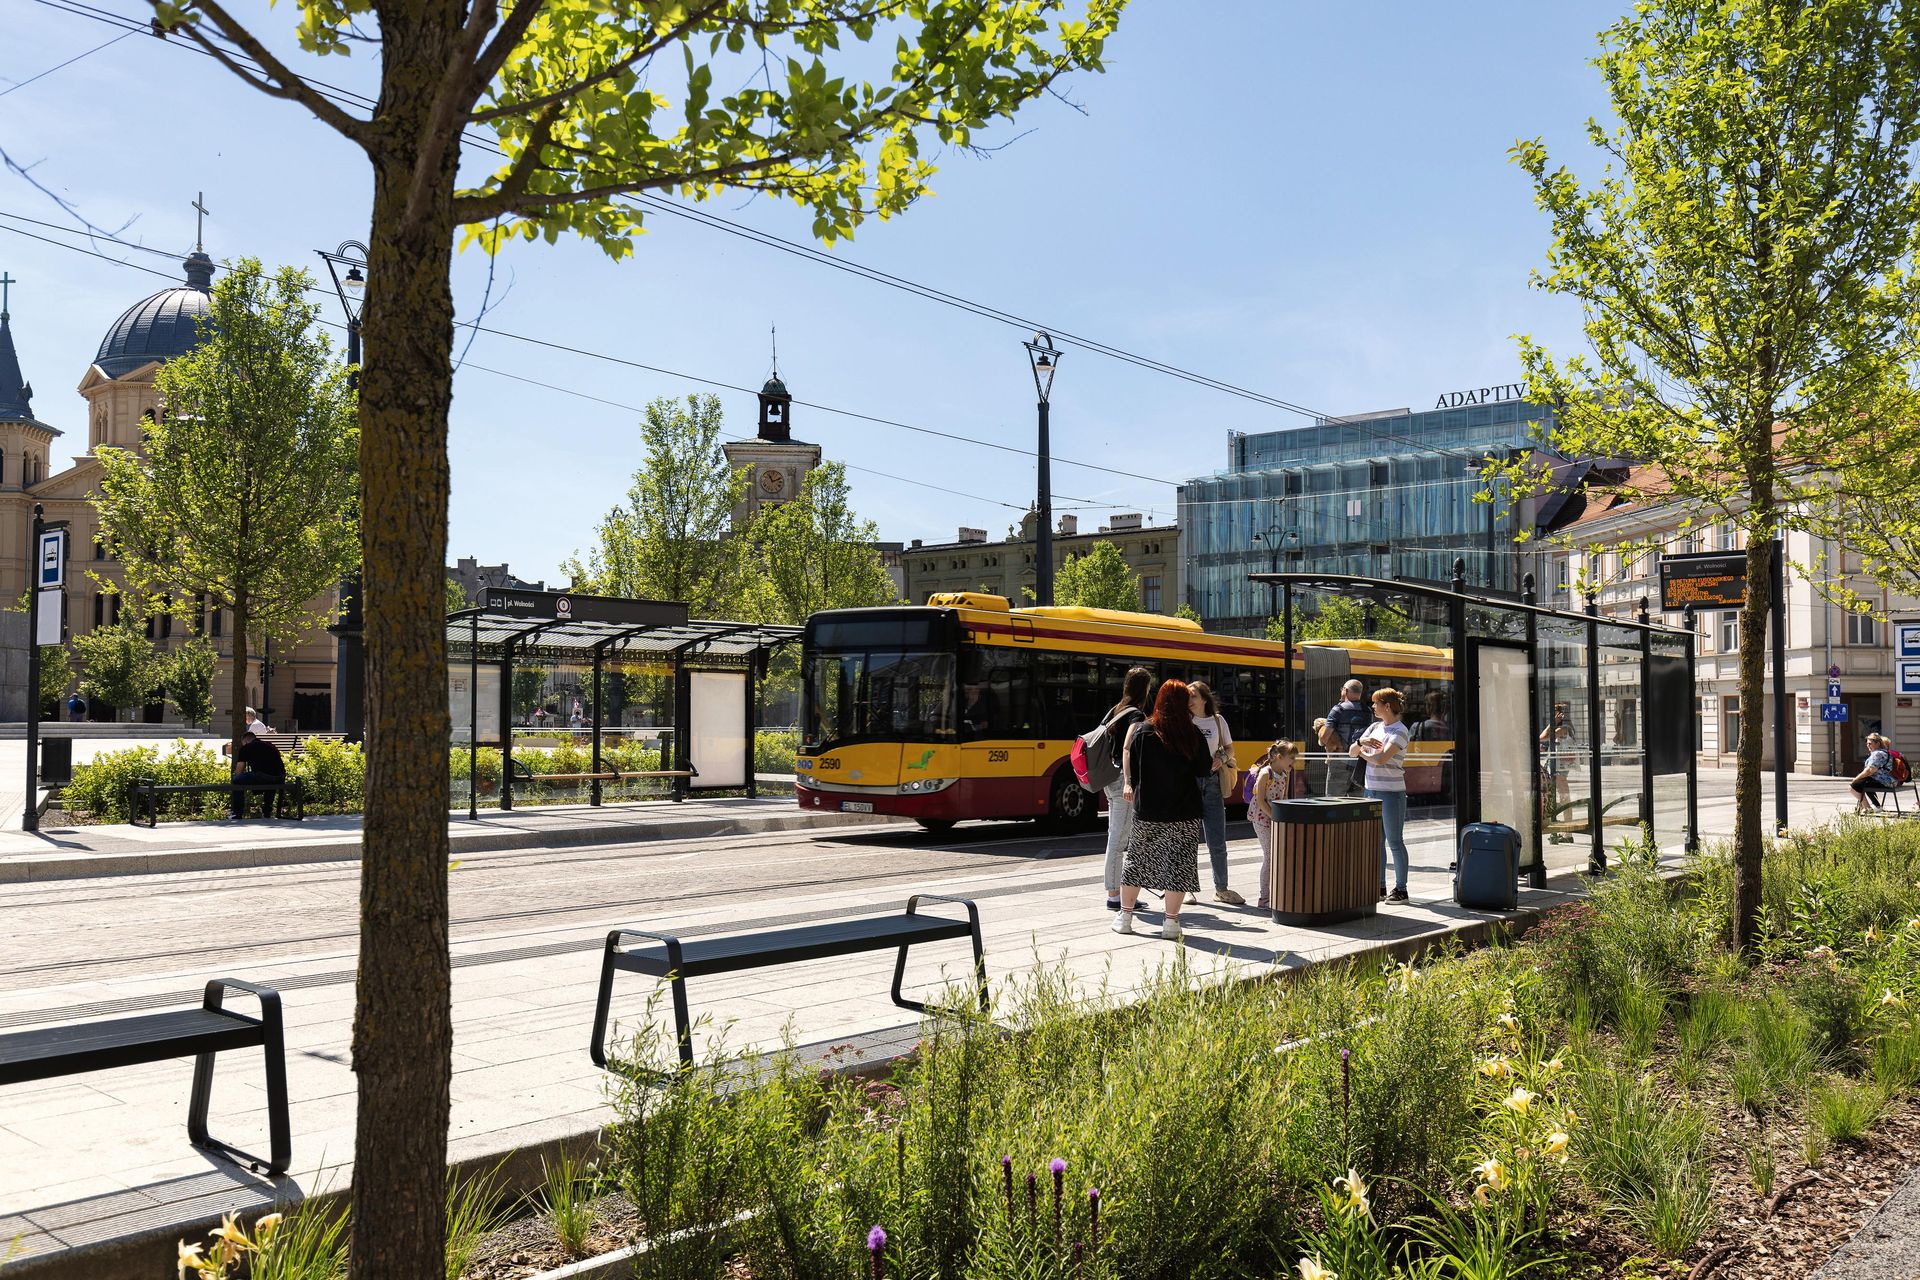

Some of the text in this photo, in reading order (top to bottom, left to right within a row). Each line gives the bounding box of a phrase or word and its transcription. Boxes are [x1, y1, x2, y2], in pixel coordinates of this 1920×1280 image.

[514, 600, 535, 608] Wolności
[987, 750, 1009, 762] 2590
[819, 758, 841, 769] 2590
